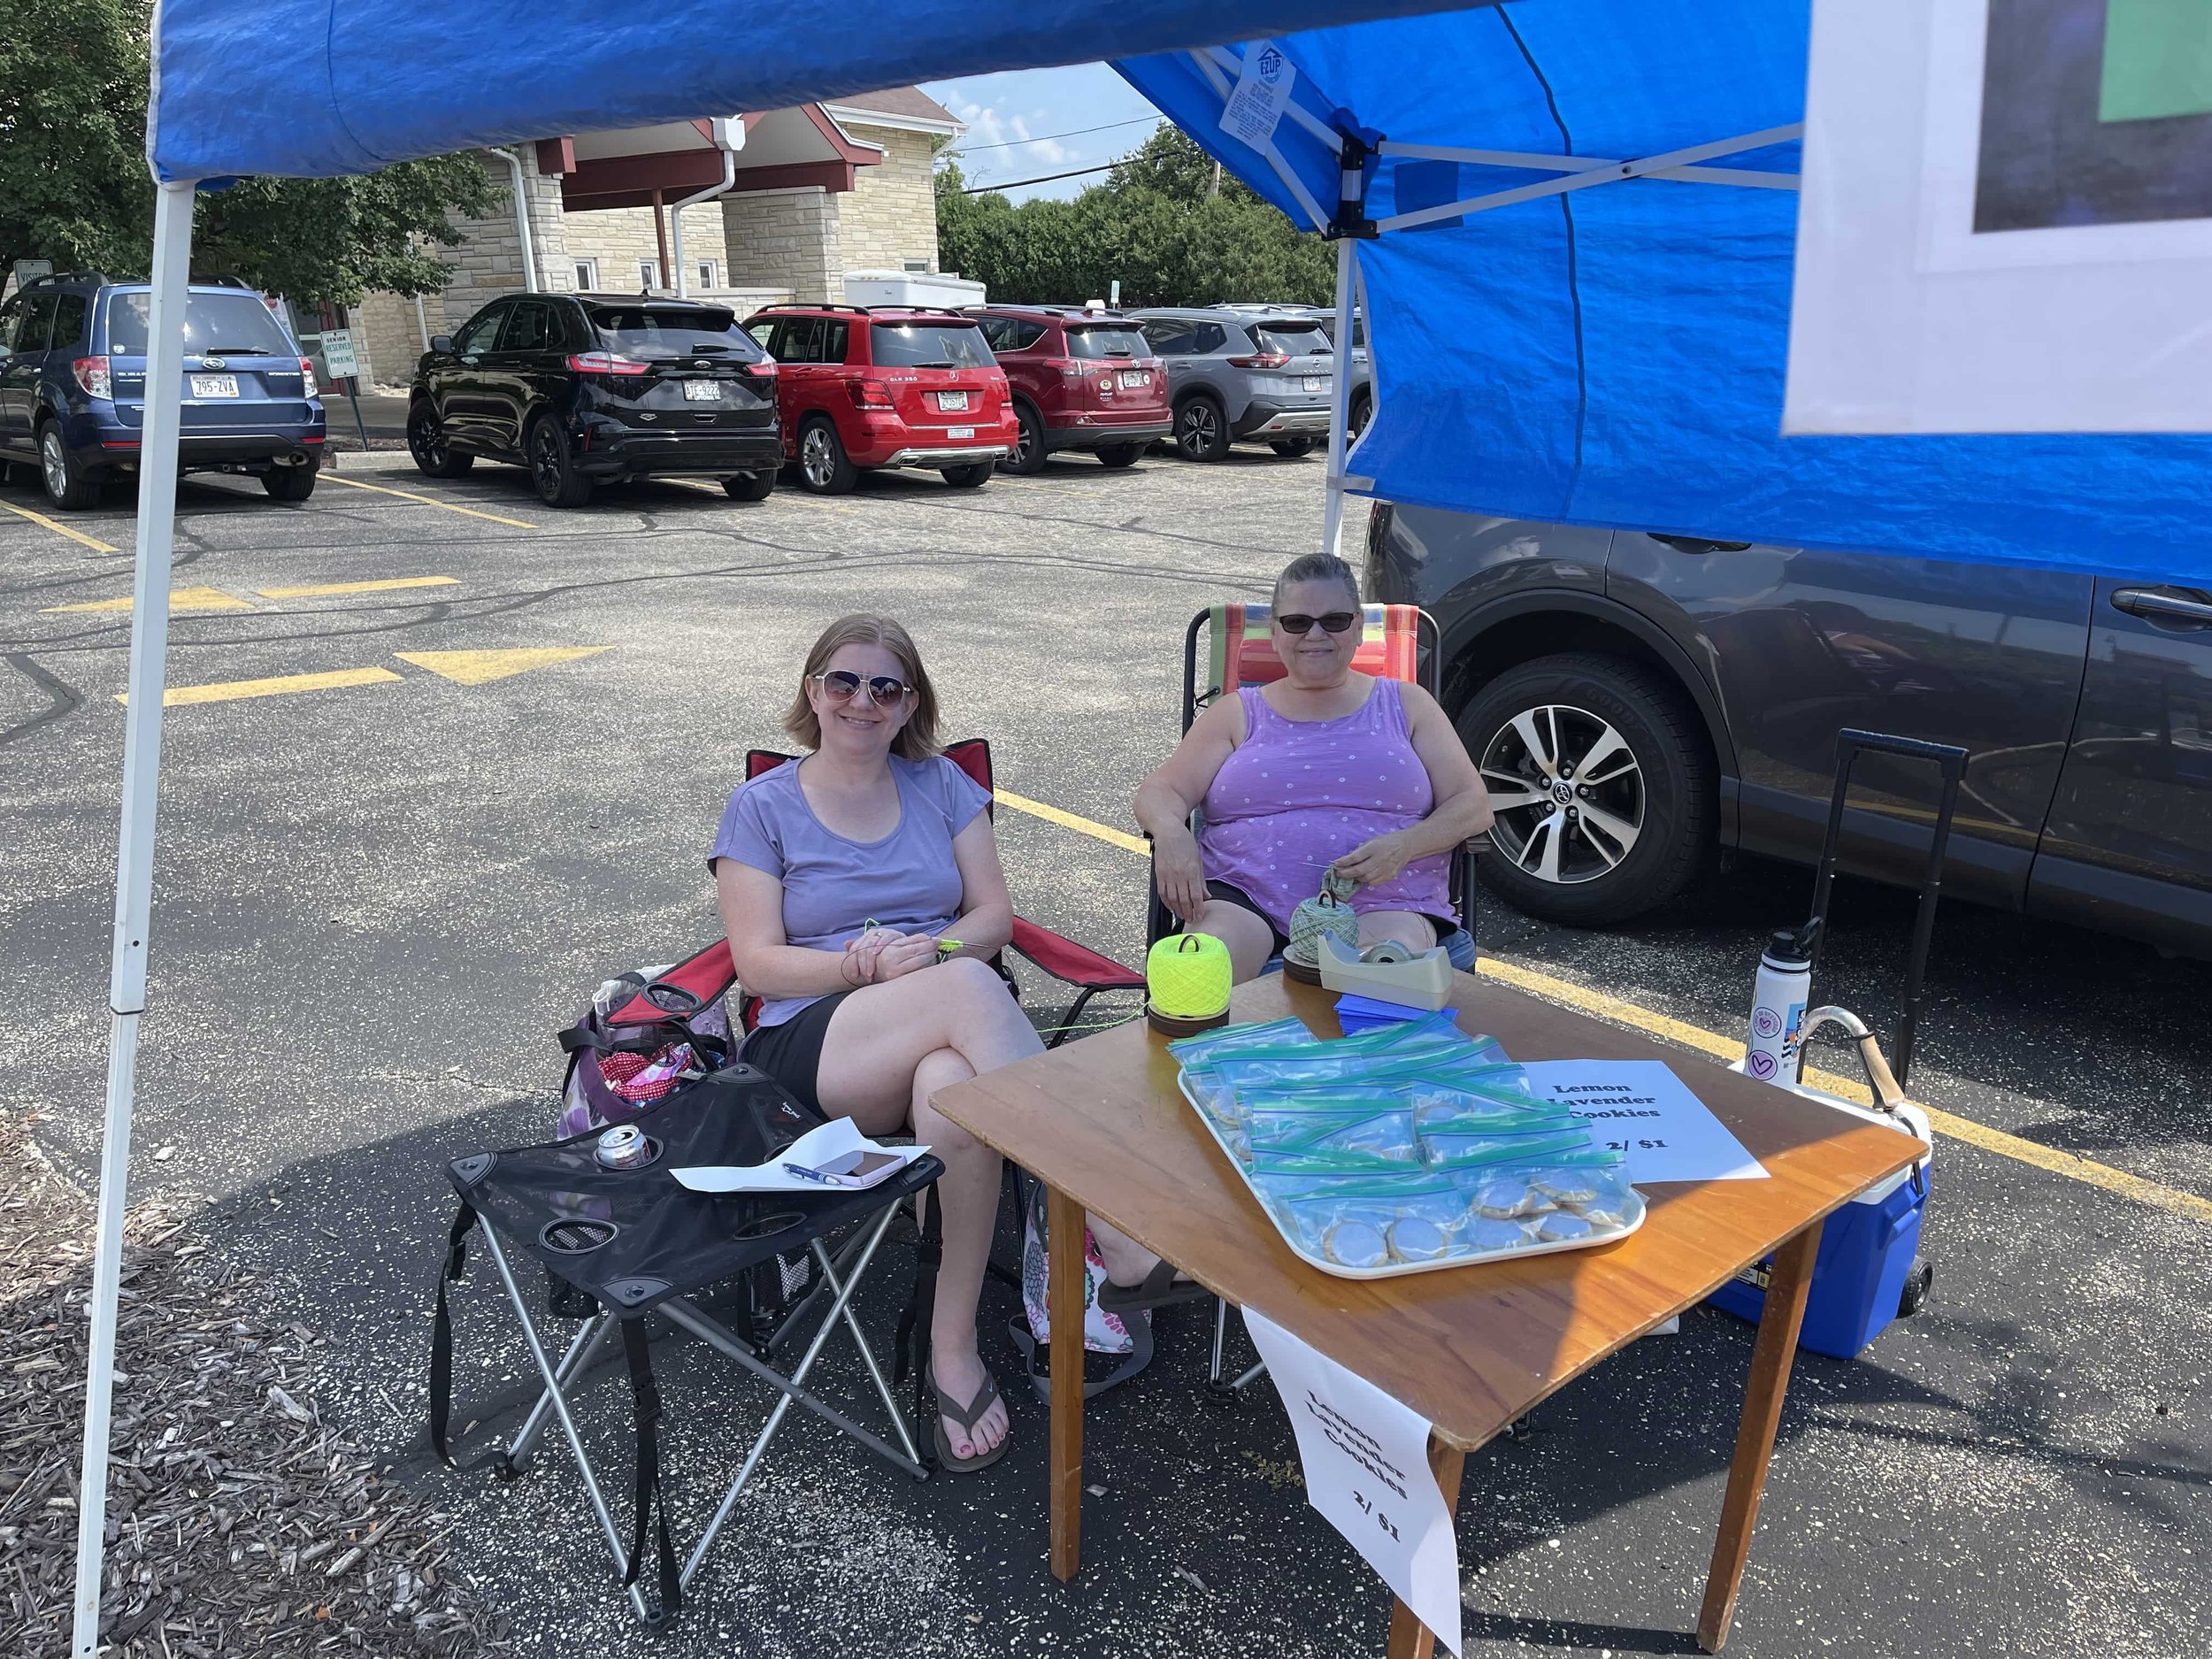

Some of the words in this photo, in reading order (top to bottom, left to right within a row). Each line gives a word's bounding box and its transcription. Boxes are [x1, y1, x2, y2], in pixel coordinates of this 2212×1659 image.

[326, 342, 351, 351] RESERVED
[330, 355, 353, 365] PARKING
[196, 380, 234, 393] 795-ZVA
[1553, 1085, 1632, 1094] Lemon
[1570, 1109, 1662, 1119] Cookies
[1606, 1140, 1629, 1152] 2/
[1639, 1139, 1669, 1149] $1
[1307, 1389, 1382, 1452] Lemon
[1304, 1400, 1406, 1481] Lavender
[1324, 1428, 1408, 1500] Cookies
[1353, 1490, 1372, 1515] 2/
[1378, 1512, 1401, 1543] $1
